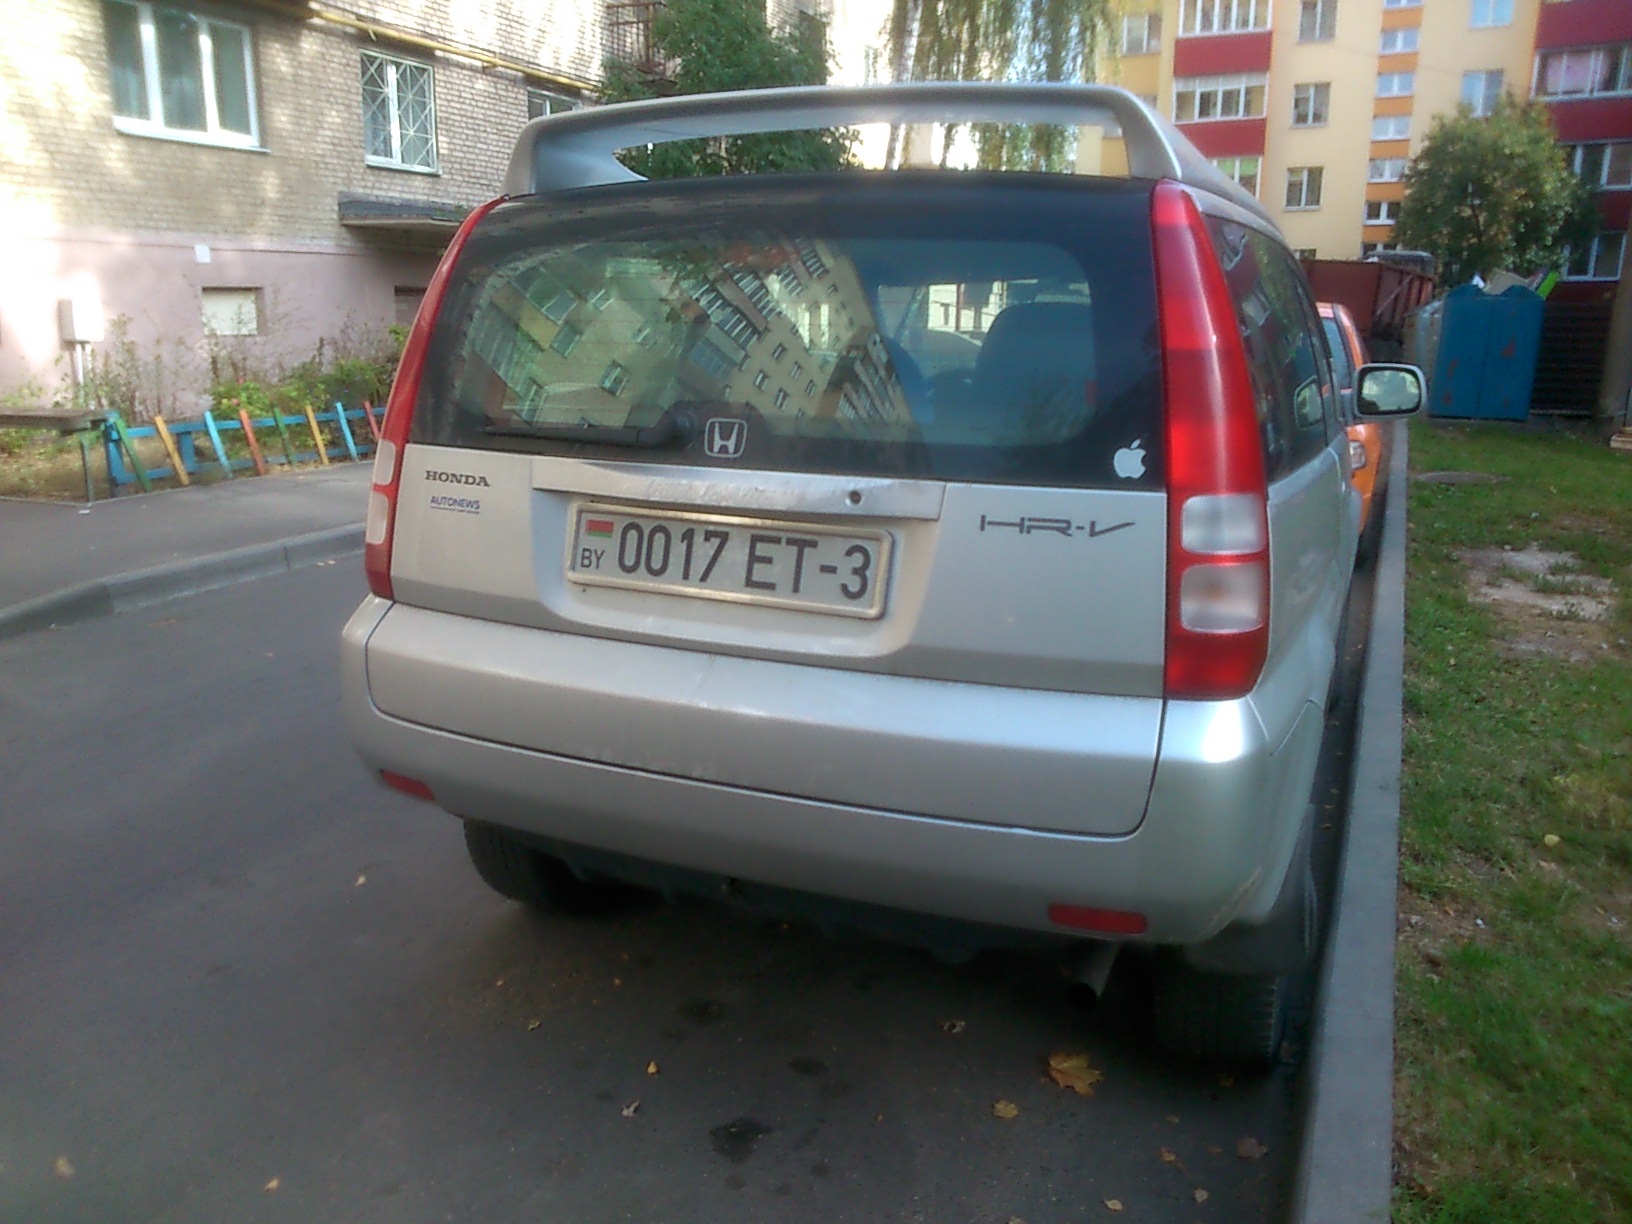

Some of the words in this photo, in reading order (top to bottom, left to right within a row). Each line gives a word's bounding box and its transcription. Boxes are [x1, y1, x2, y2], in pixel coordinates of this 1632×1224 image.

[425, 470, 490, 487] HONDA
[430, 495, 480, 510] AUTONEWS
[980, 514, 1136, 537] HR-V
[580, 547, 606, 570] BY
[618, 521, 730, 584] 0017
[744, 535, 872, 600] ET-3
